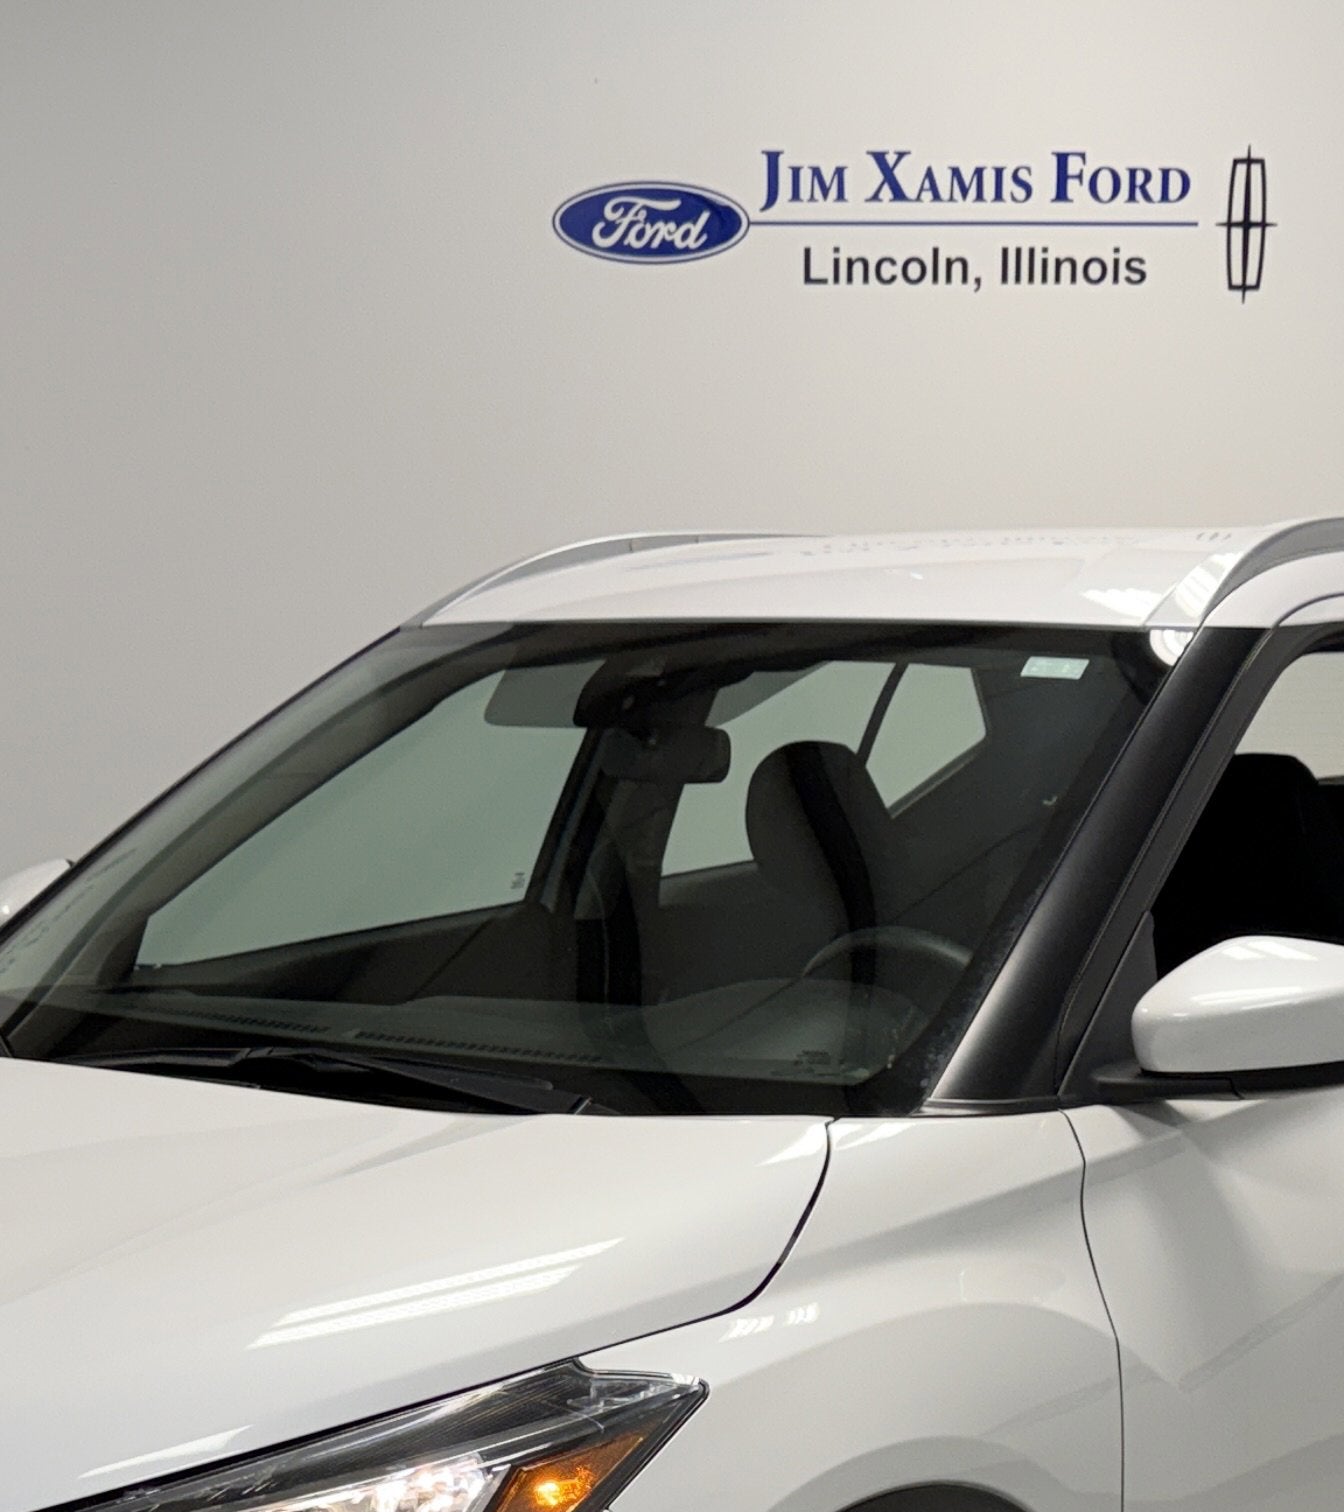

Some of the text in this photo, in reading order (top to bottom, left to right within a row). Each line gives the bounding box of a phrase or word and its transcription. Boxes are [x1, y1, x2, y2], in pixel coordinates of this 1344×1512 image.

[759, 149, 1191, 212] JIM XAMIS FORD
[591, 195, 711, 250] Ford
[803, 246, 1147, 292] Lincoln, Illinois
